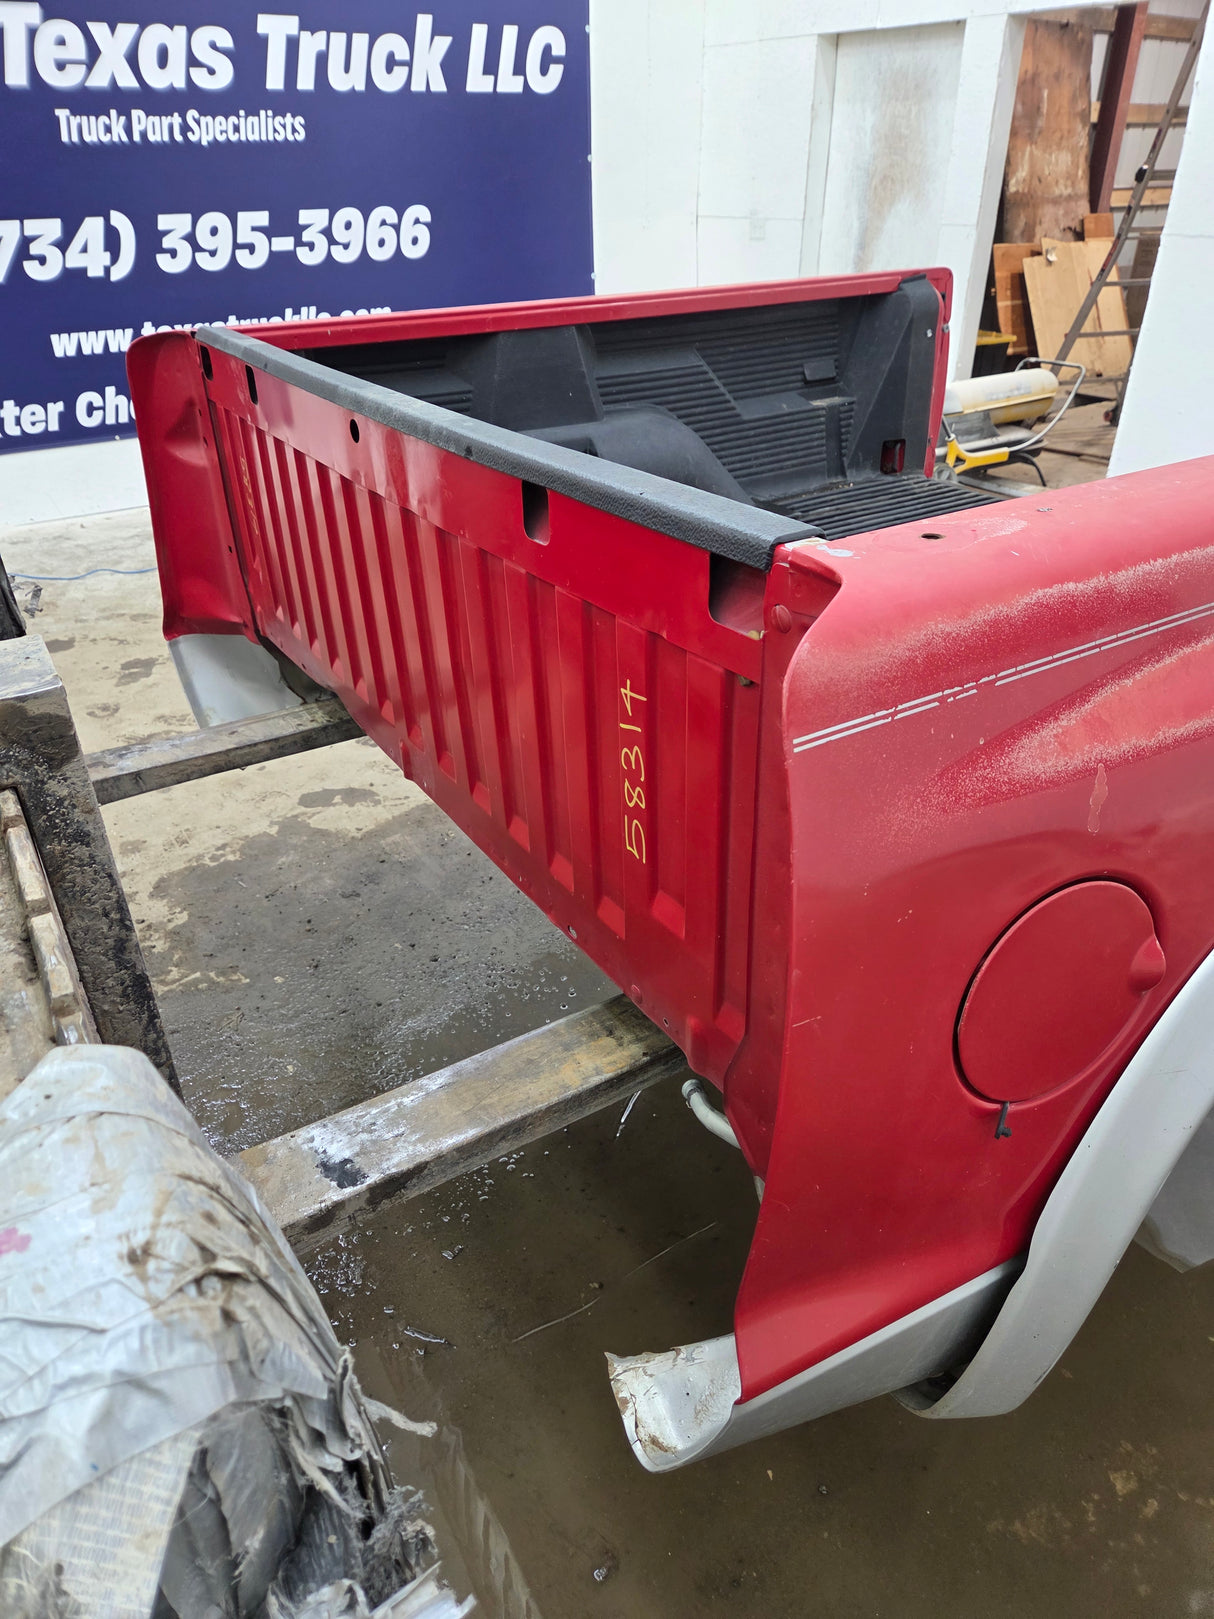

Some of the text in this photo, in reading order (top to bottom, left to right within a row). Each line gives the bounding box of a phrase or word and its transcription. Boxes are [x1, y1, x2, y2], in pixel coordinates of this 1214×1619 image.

[0, 2, 567, 95] Texas Truck LLC
[54, 108, 306, 146] Truck Part Specialists
[155, 204, 432, 274] 395-3966
[75, 385, 136, 428] Ch
[619, 678, 648, 865] 58314
